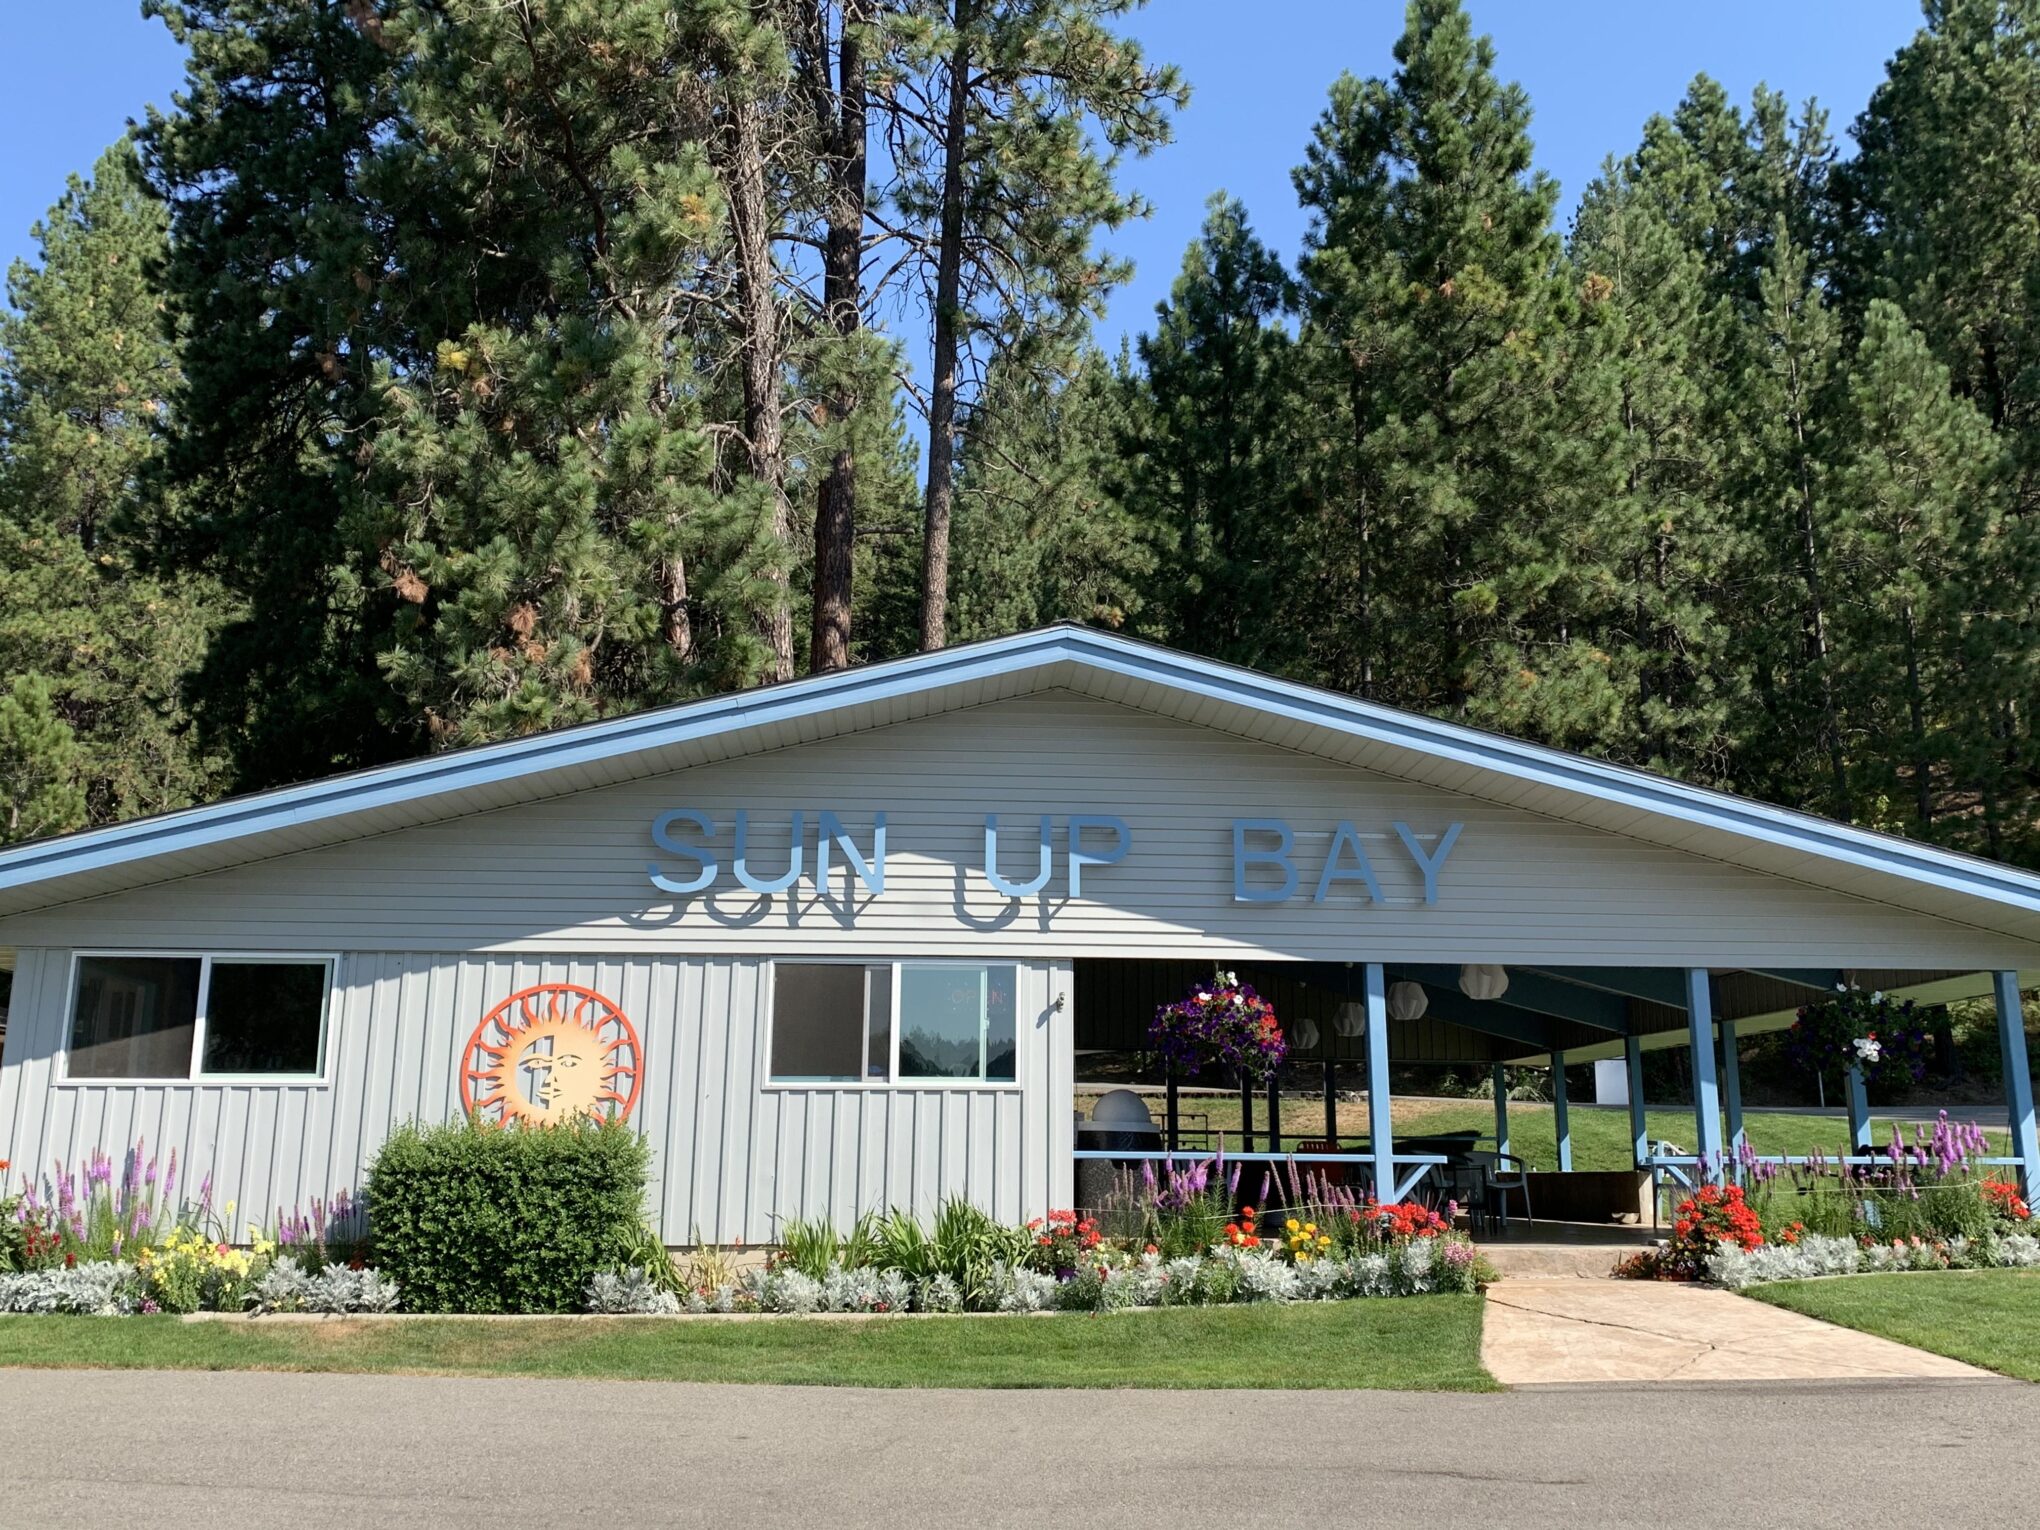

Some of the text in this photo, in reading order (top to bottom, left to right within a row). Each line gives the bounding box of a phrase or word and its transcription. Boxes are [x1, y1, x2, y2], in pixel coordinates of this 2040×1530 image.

[647, 808, 1465, 905] SUN UP BAY
[951, 989, 1004, 1005] OPN
